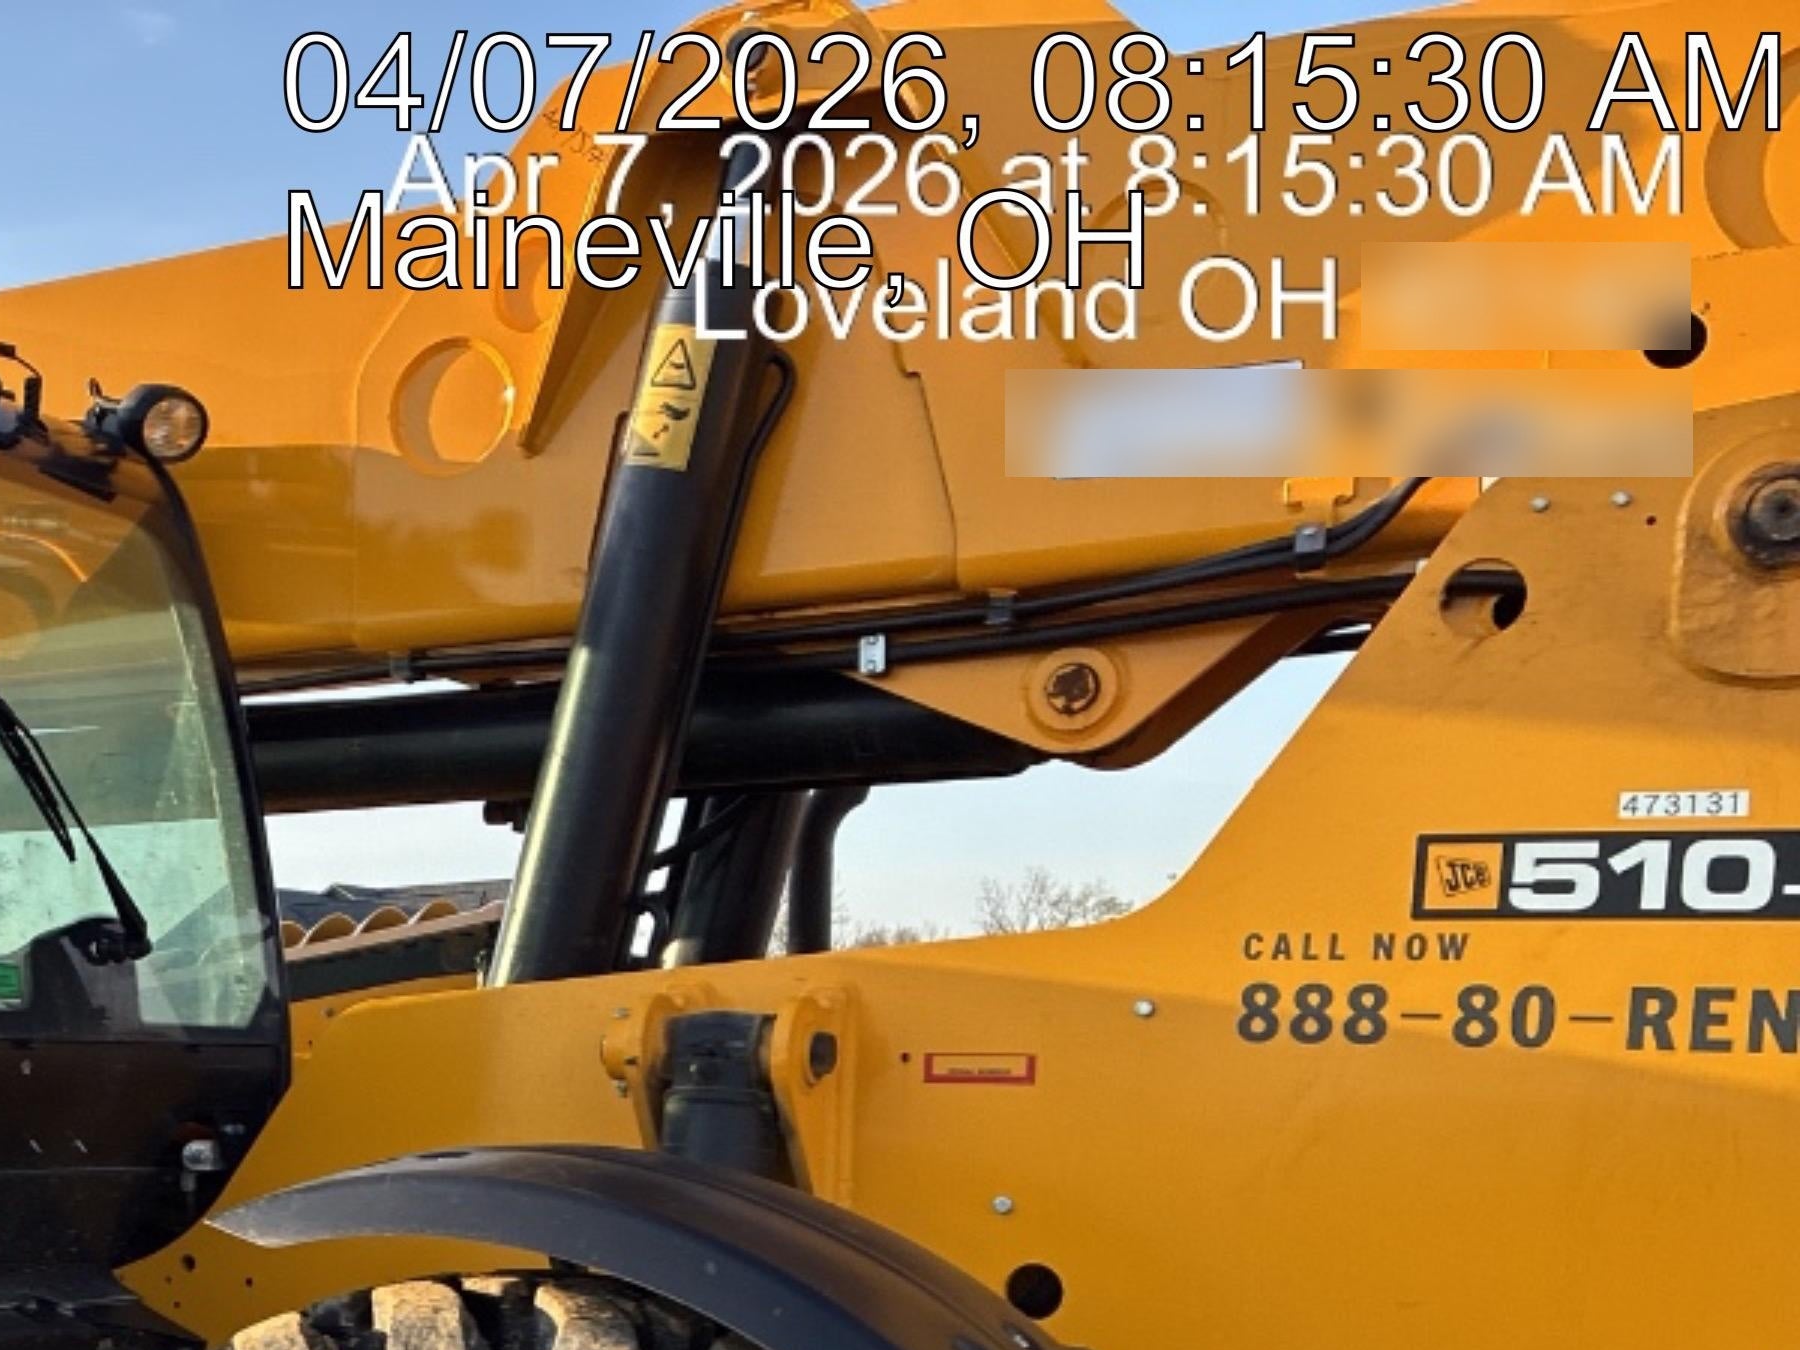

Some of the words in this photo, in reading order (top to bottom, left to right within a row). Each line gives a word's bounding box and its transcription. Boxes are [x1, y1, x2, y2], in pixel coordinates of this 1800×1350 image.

[1621, 792, 1743, 816] 473131
[1243, 932, 1346, 961] CALL
[1372, 932, 1469, 961] NOW
[1237, 982, 1800, 1054] 888-80-REN
